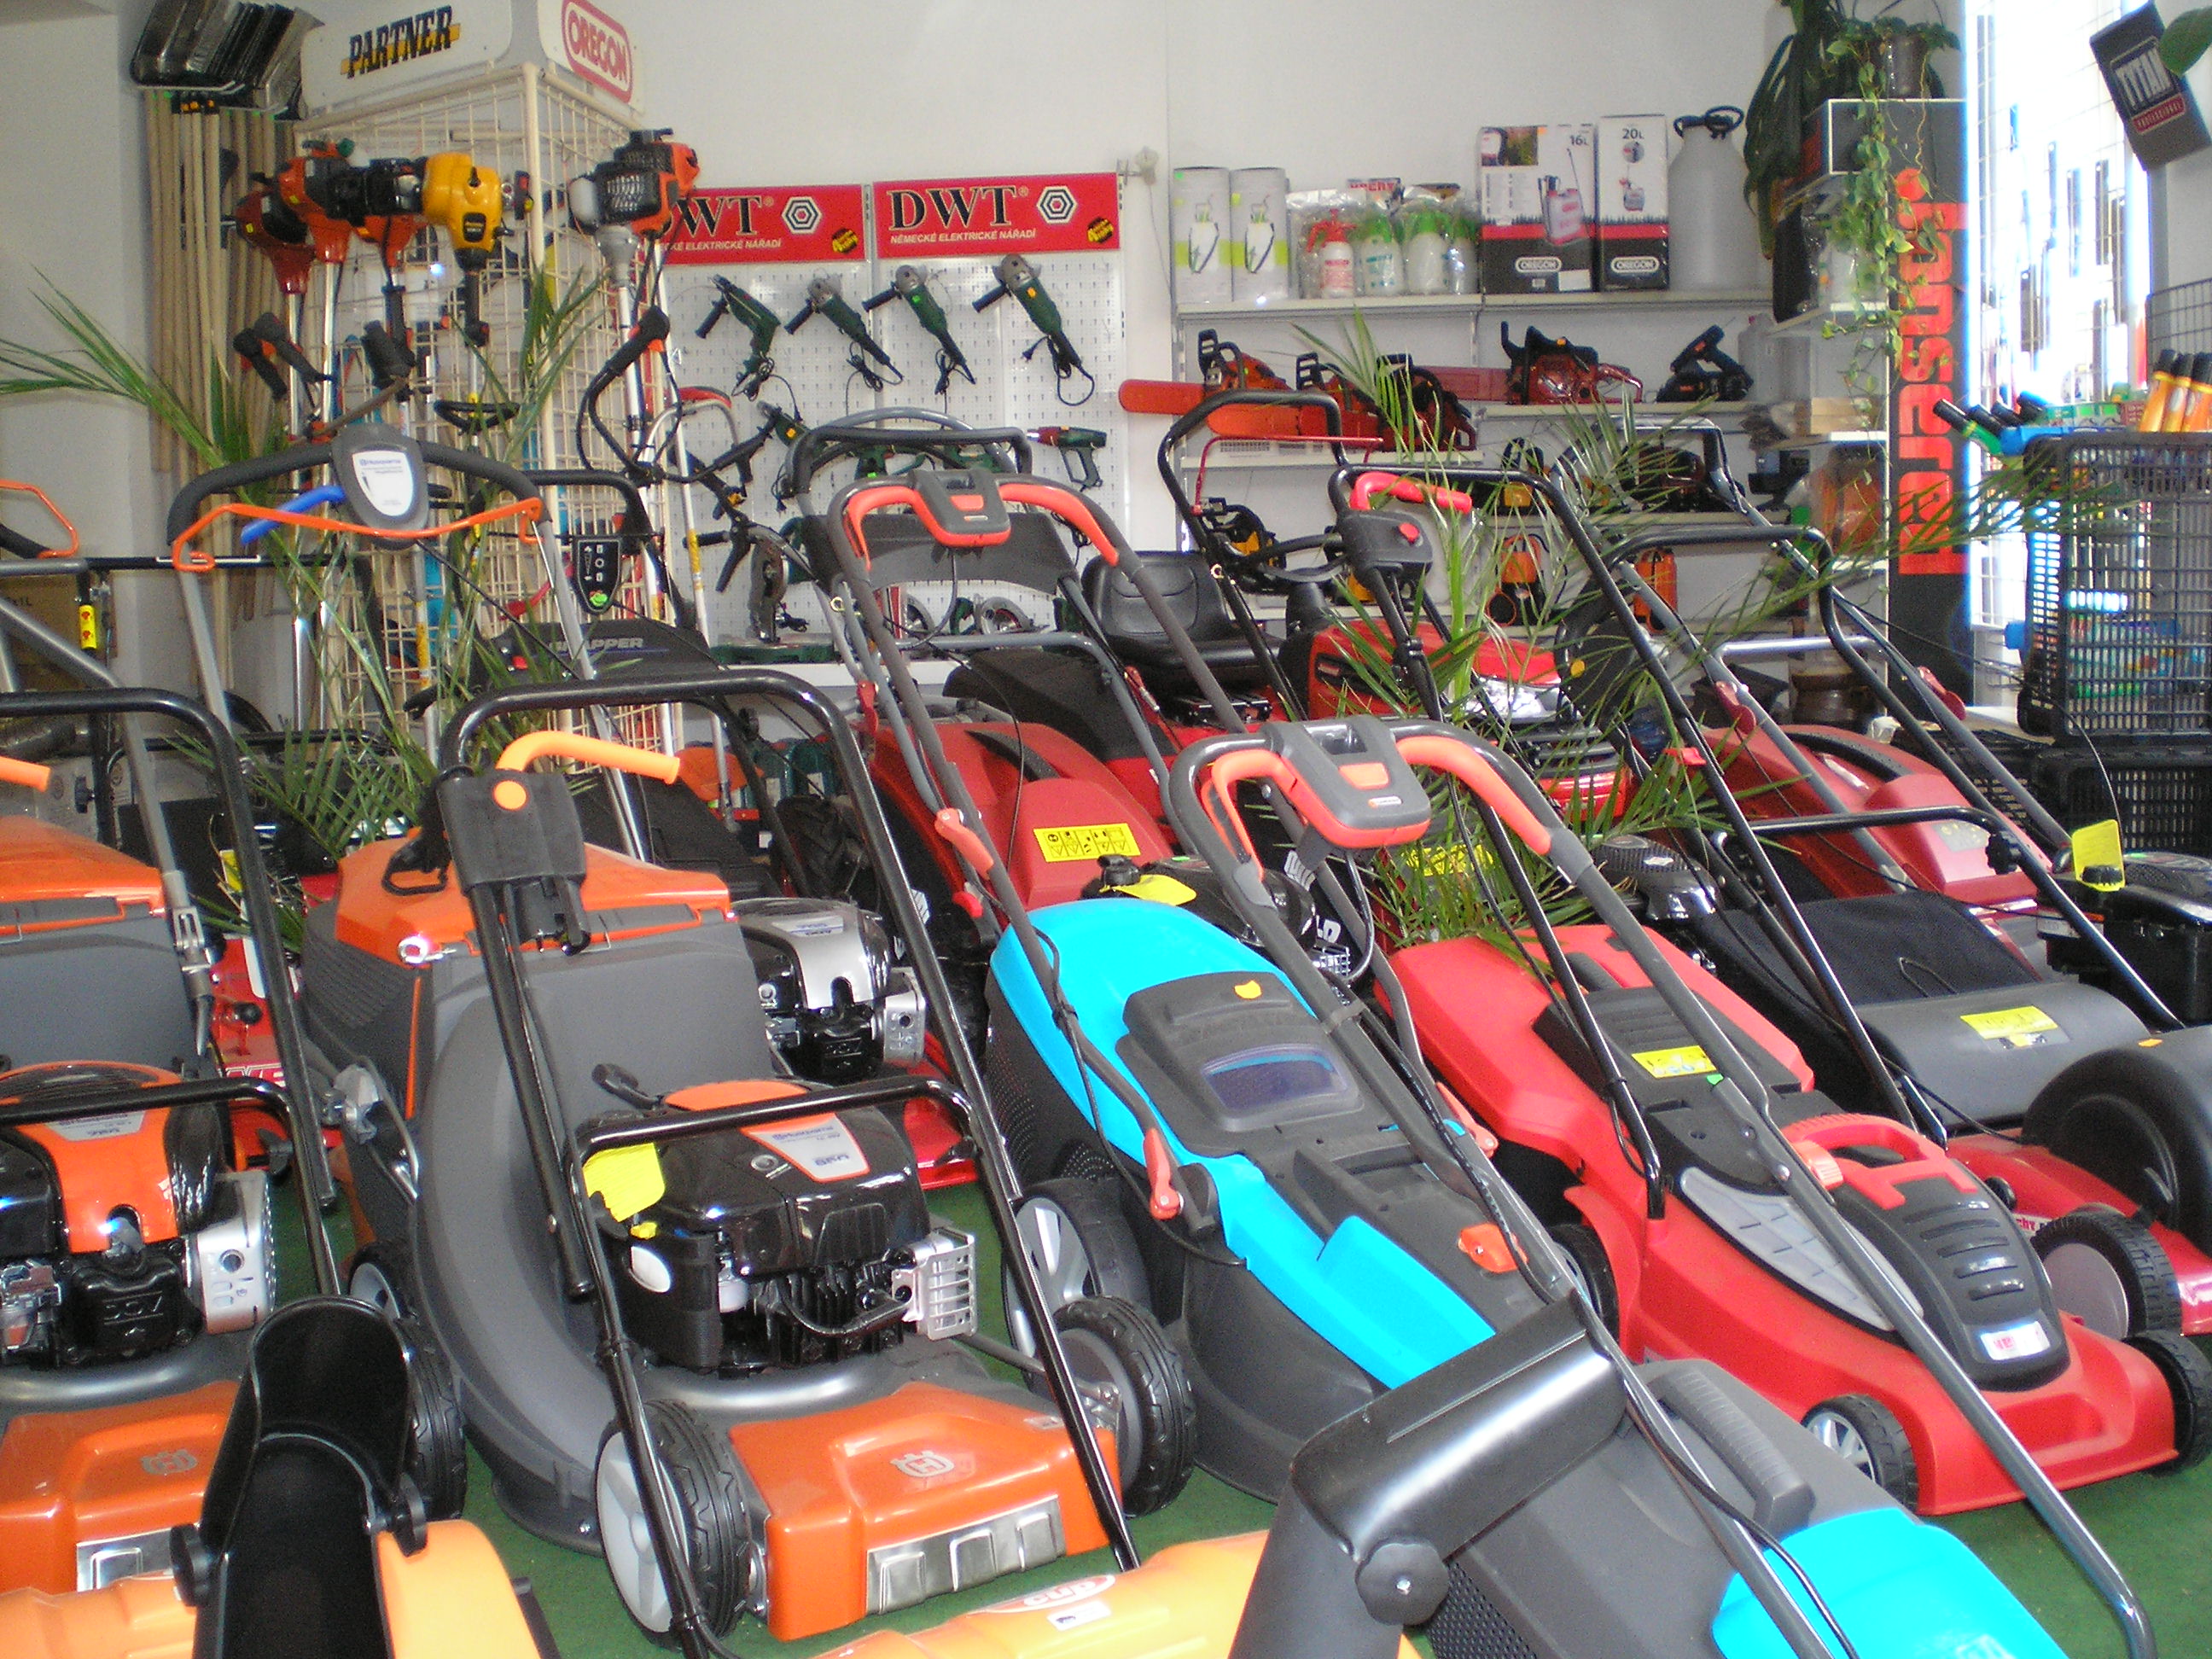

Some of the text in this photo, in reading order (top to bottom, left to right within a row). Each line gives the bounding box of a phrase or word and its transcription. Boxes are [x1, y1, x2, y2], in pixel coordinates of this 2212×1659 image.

[346, 5, 452, 79] PARTNER
[566, 9, 629, 84] OREGON
[659, 195, 762, 239] WT
[887, 184, 1016, 230] DWT
[1520, 260, 1557, 270] OREGON
[1616, 260, 1655, 270] OREGON
